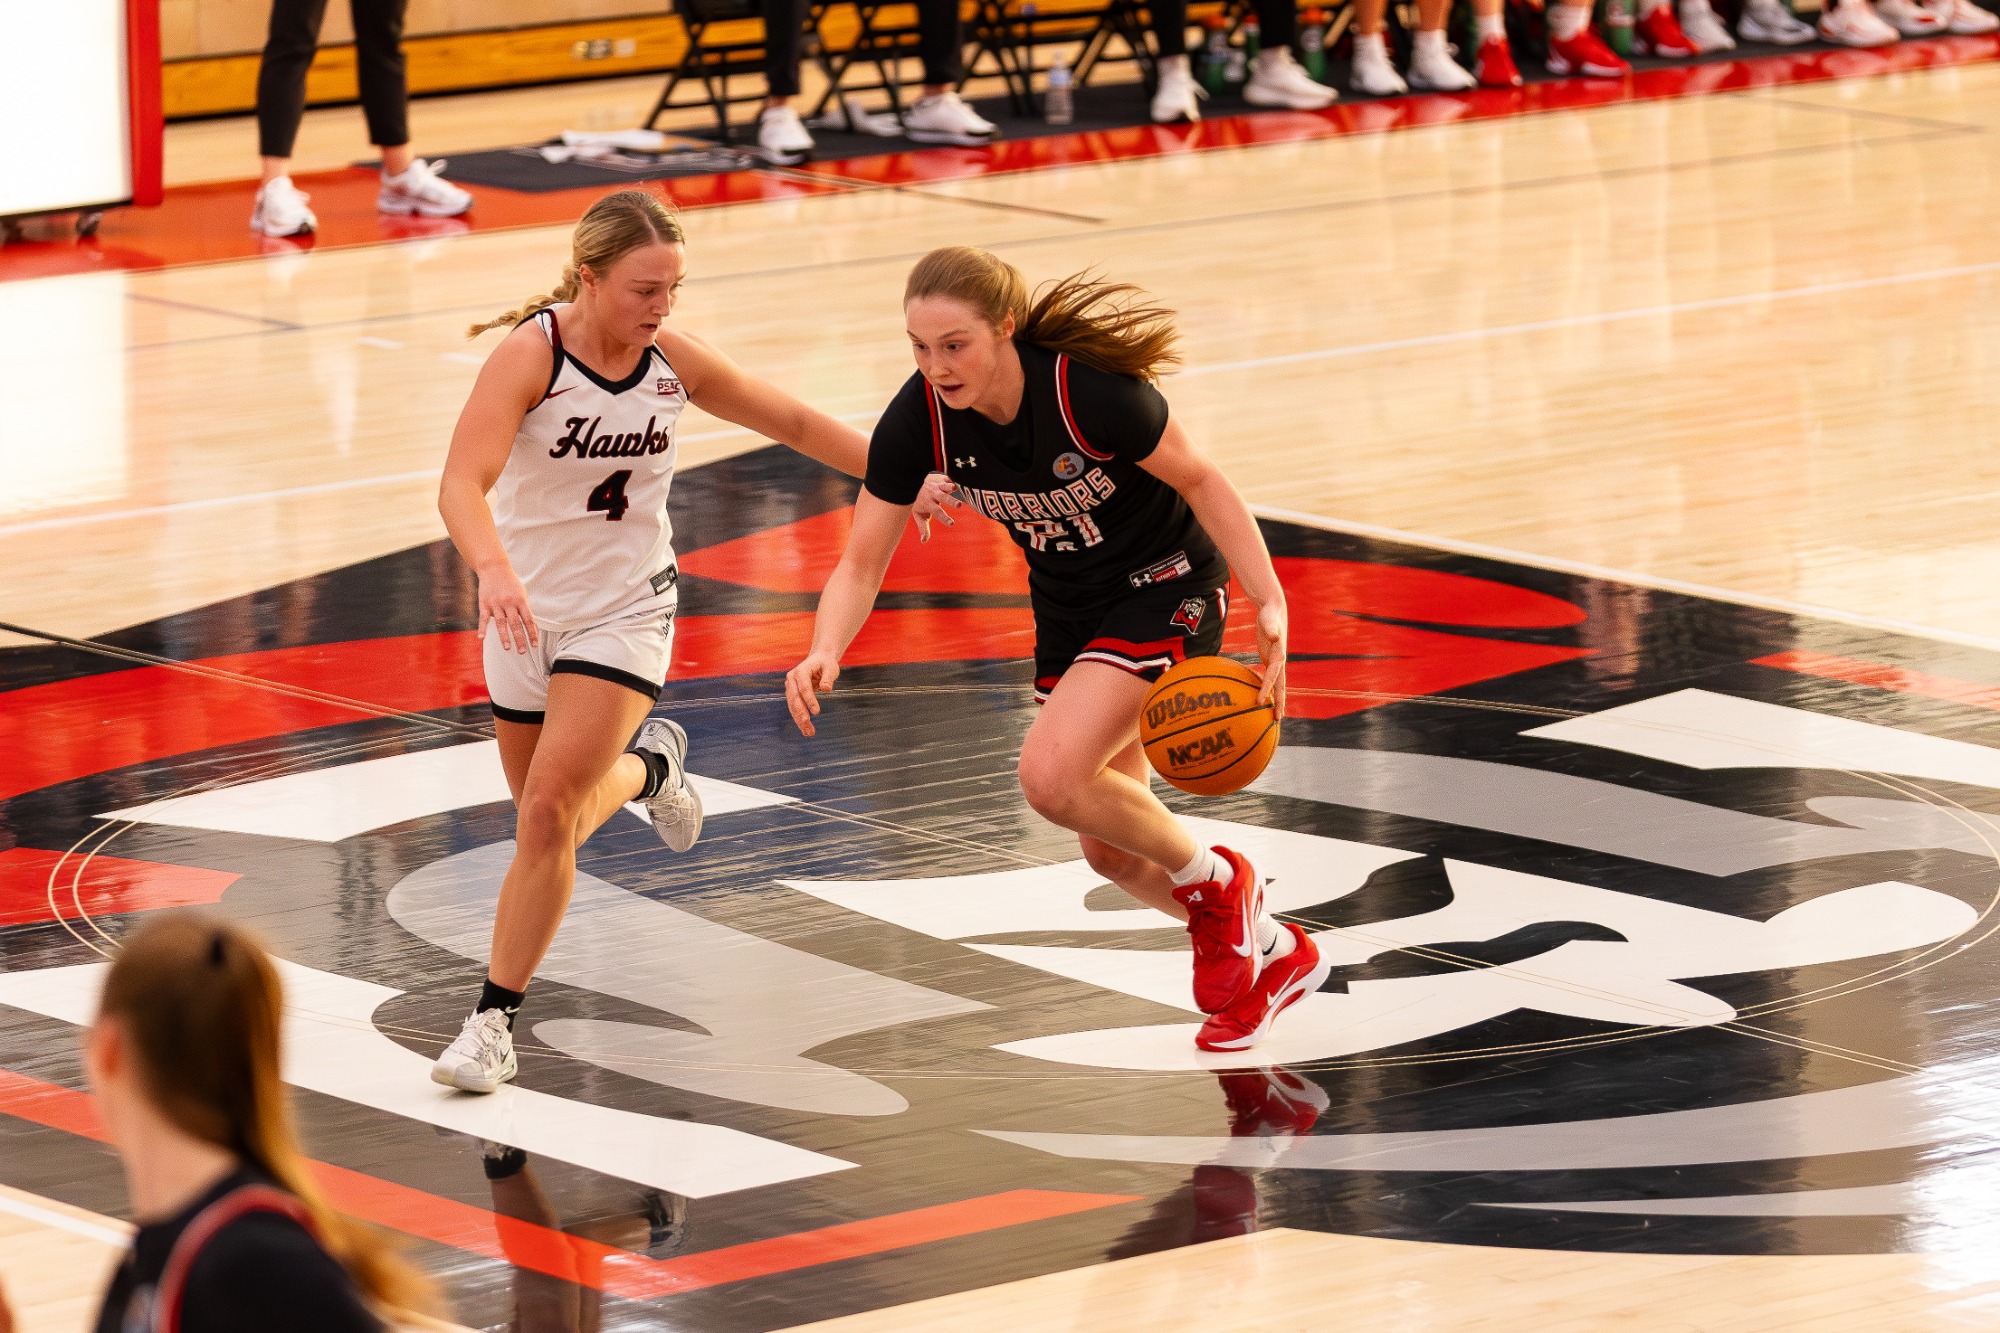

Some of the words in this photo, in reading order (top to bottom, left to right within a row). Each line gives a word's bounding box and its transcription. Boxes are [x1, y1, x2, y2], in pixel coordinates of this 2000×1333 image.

[657, 382, 681, 391] PSAC
[549, 415, 669, 458] Hawks
[587, 470, 633, 521] 4
[954, 467, 1117, 521] WARRIORS
[1146, 691, 1232, 729] Wilson
[1167, 729, 1235, 767] NCAA
